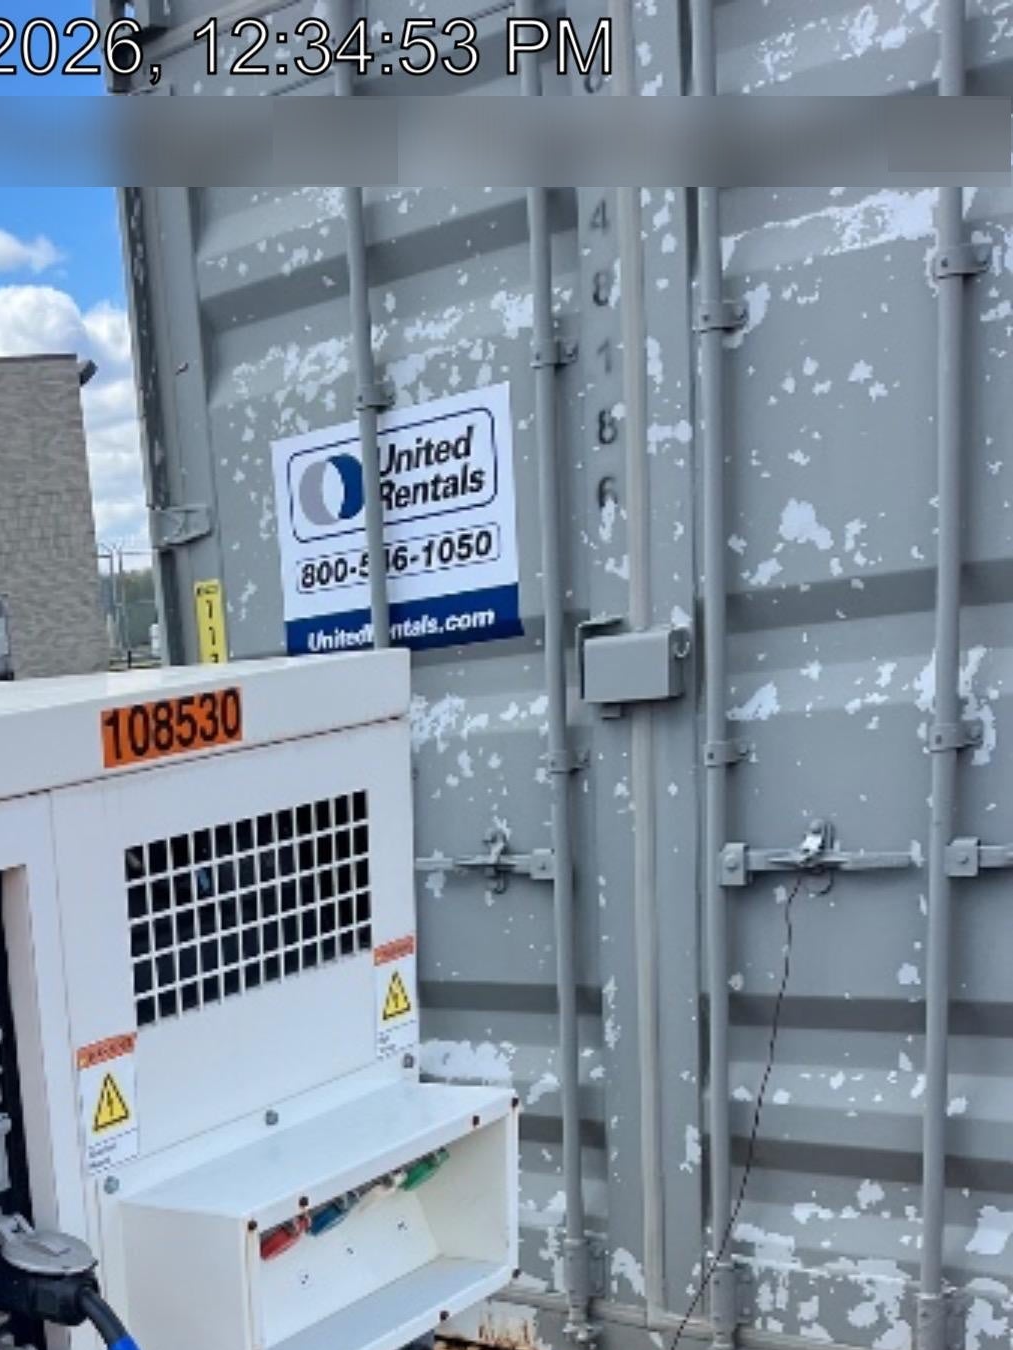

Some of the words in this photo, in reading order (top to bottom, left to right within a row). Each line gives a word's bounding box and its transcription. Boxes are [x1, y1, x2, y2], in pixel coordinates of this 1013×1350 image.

[377, 424, 475, 477] United
[379, 462, 485, 511] Rentals
[301, 530, 493, 588] 800-56-1050
[307, 609, 495, 651] UnitedRntals.com
[105, 686, 240, 760] 108530
